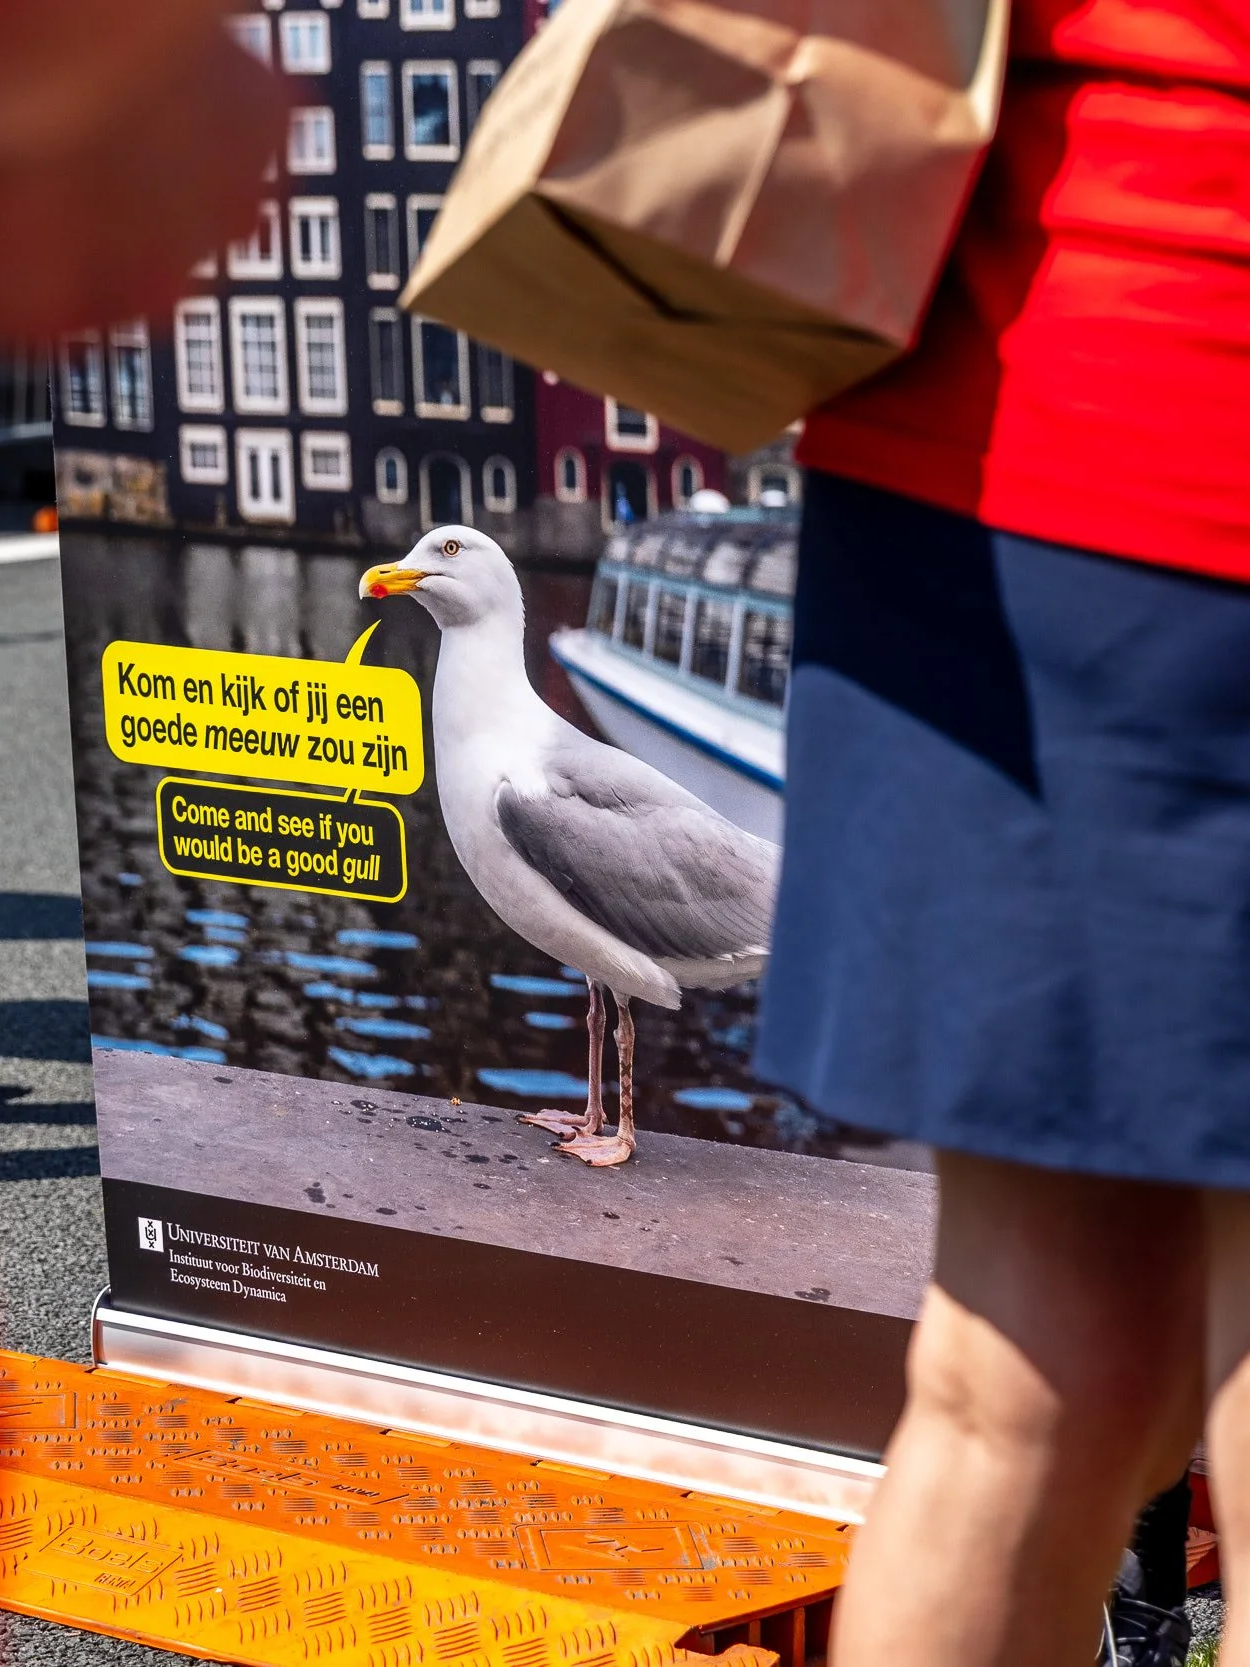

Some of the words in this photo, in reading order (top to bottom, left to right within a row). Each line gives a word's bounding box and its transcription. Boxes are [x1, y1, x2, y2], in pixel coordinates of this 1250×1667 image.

[117, 661, 176, 698] Kom
[183, 678, 213, 704] en
[221, 673, 267, 716] kijk
[274, 681, 299, 713] of
[306, 682, 328, 724] jij
[336, 693, 384, 722] een
[121, 713, 197, 747] goede
[204, 724, 300, 757] meeuw
[308, 734, 354, 765] zou
[362, 735, 408, 776] zijn
[172, 796, 230, 829] Come
[235, 807, 272, 833] and
[277, 814, 314, 839] see
[319, 813, 332, 840] if
[337, 823, 374, 848] you
[174, 834, 233, 861] would
[237, 839, 263, 865] be
[268, 847, 281, 868] a
[286, 849, 338, 876] good
[342, 855, 380, 884] gull
[167, 1222, 260, 1256] UNIVERSITEIT
[263, 1243, 290, 1262] VAN
[293, 1245, 380, 1278] AMSTERDAM
[169, 1249, 213, 1270] Instituut
[215, 1260, 239, 1275] voor
[242, 1262, 311, 1289] Biodiversiteit
[313, 1278, 327, 1291] en
[170, 1268, 231, 1292] Ecosysteem
[232, 1280, 287, 1303] Dynamica
